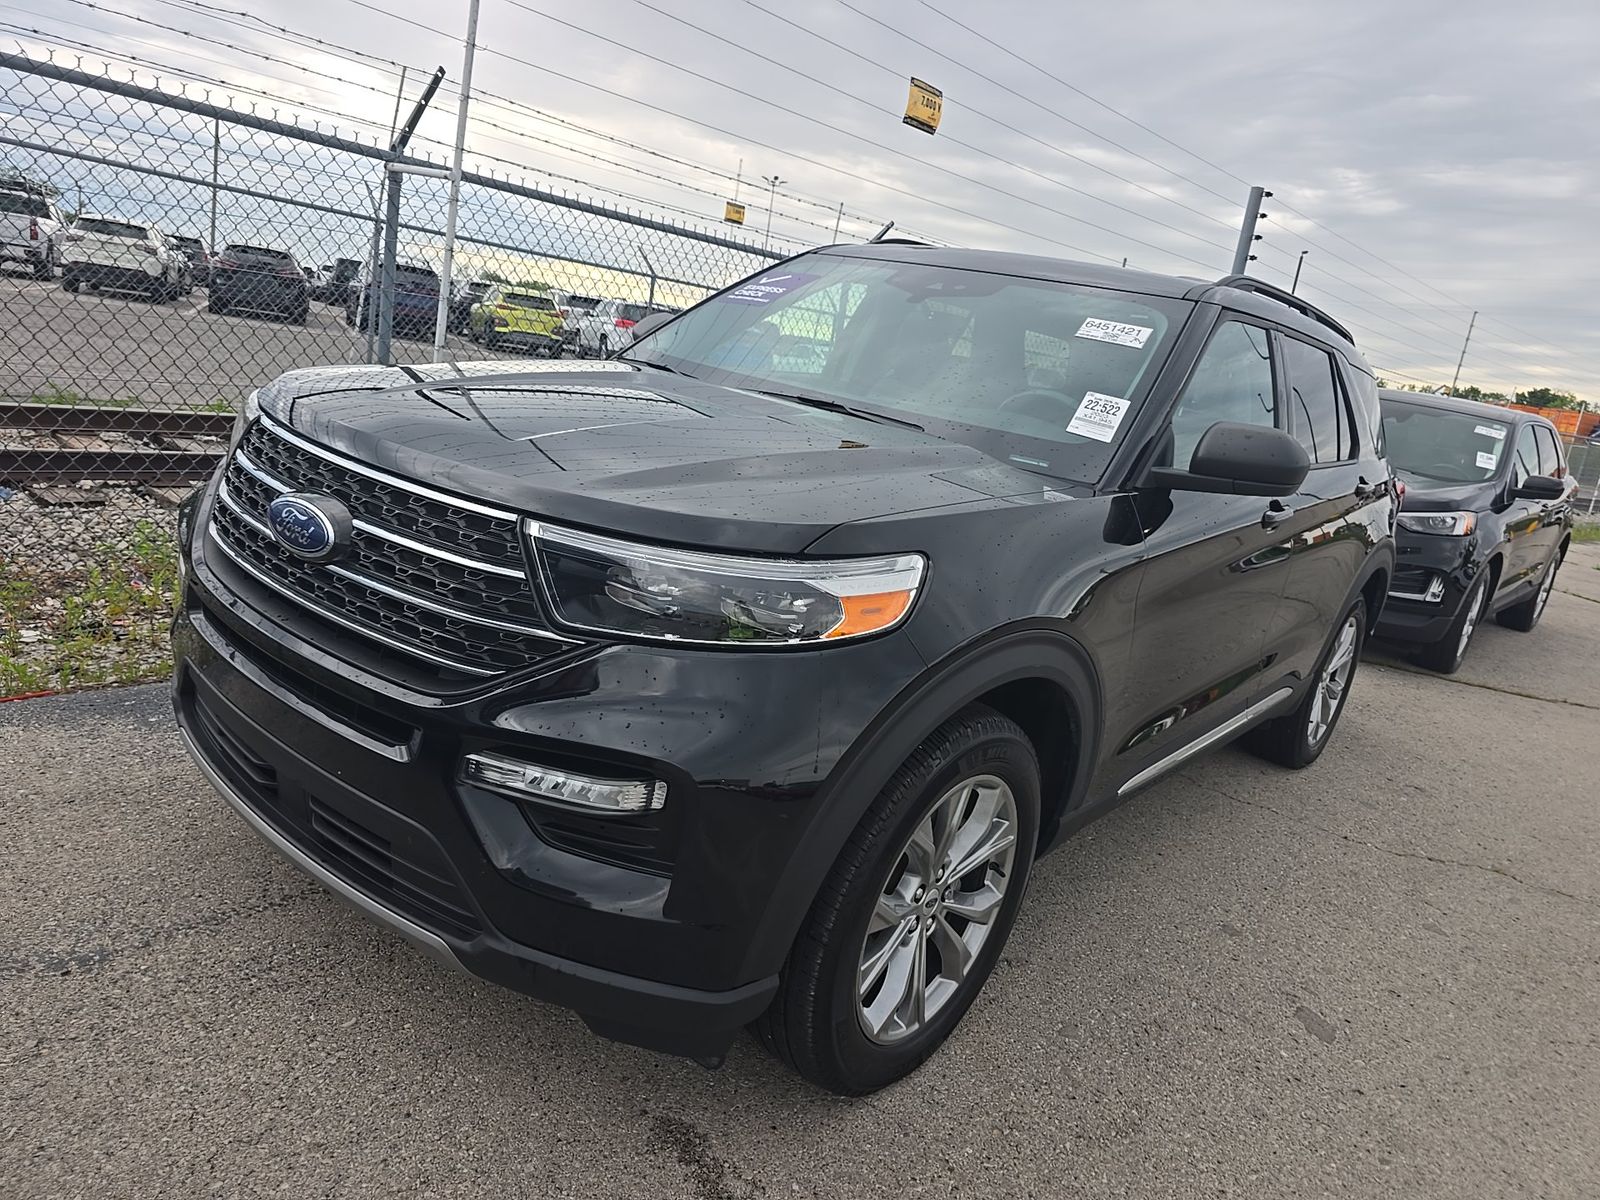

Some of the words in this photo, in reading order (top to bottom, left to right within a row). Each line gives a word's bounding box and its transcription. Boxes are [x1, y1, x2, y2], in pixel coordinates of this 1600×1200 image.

[743, 284, 787, 294] EXPRESS
[1085, 320, 1142, 337] 6451421
[1084, 399, 1121, 417] 22:522
[276, 506, 315, 545] Ford
